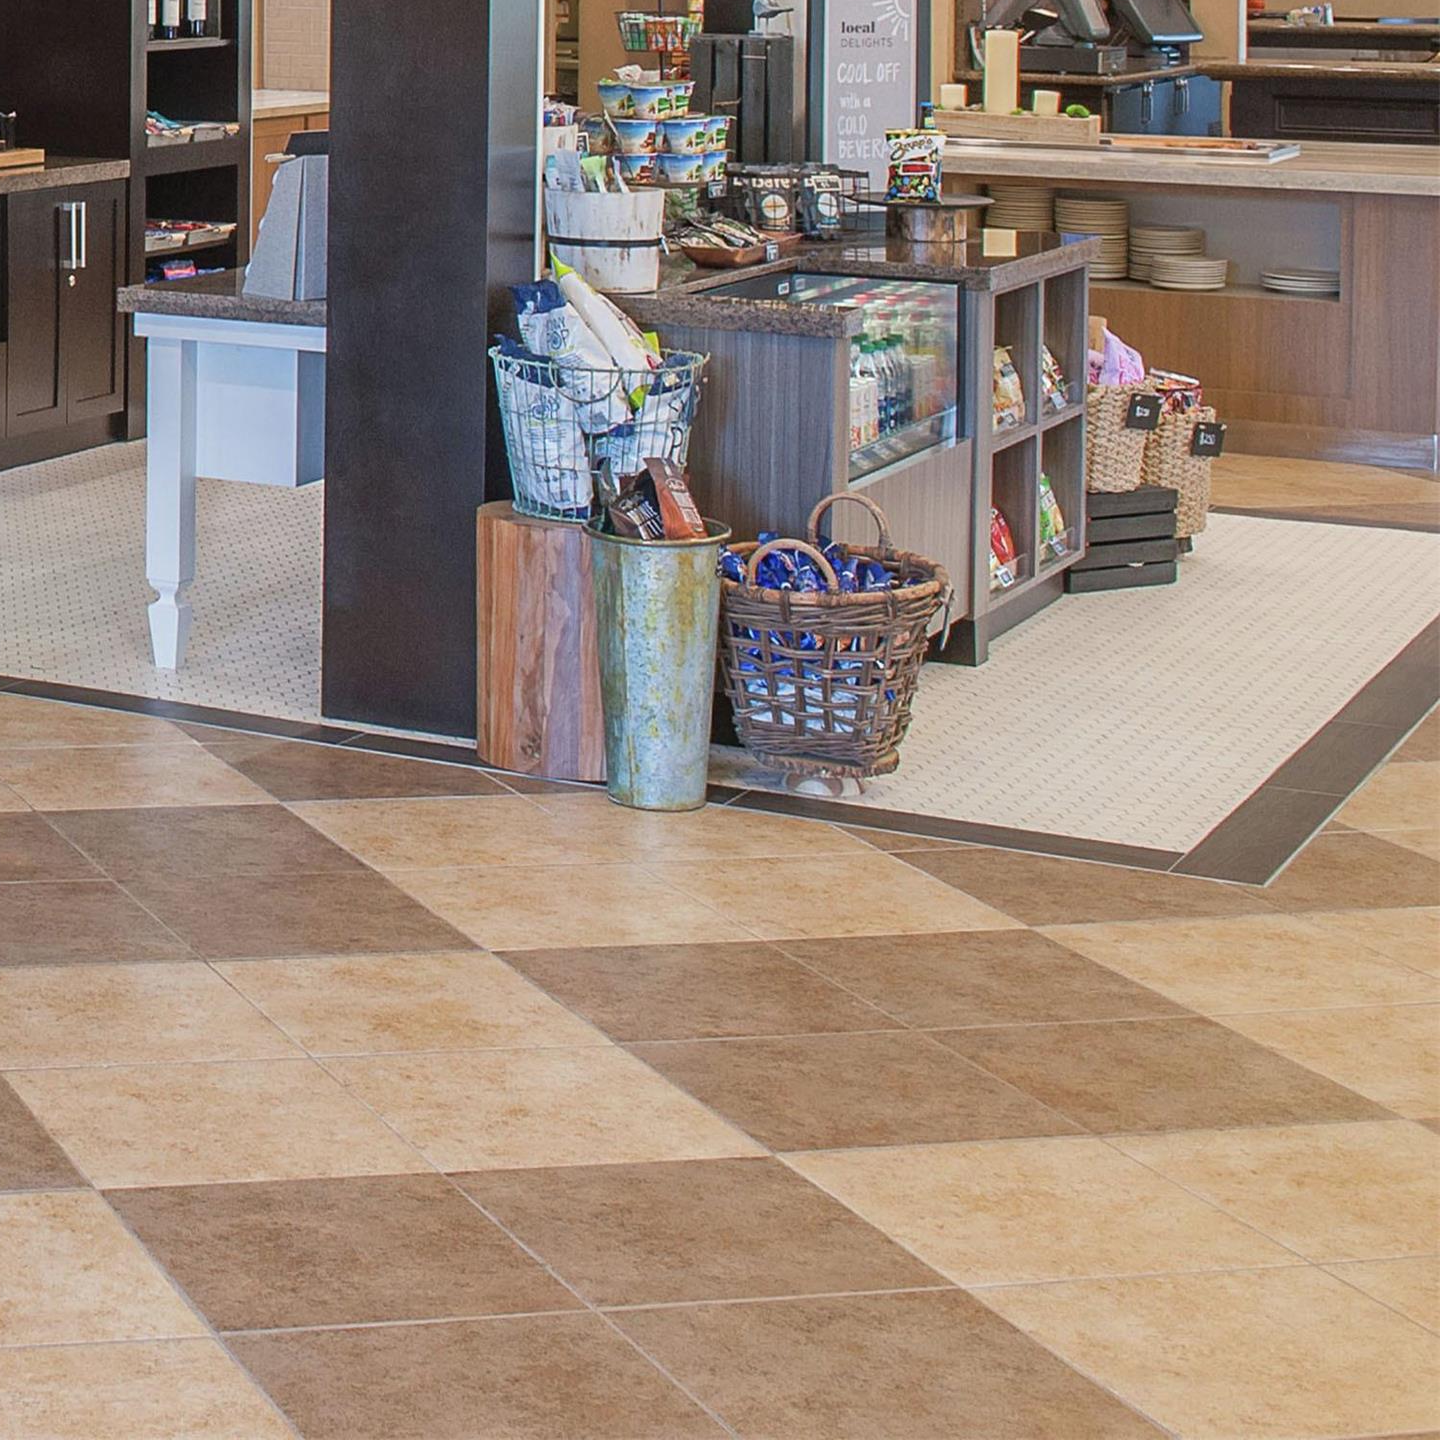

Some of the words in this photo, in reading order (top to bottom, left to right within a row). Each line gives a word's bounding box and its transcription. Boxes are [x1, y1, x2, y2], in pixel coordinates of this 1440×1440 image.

[841, 21, 875, 34] local
[840, 37, 893, 48] DELIGHTS
[837, 62, 872, 84] COOL
[876, 62, 901, 83] OFF
[837, 114, 867, 136] COLD
